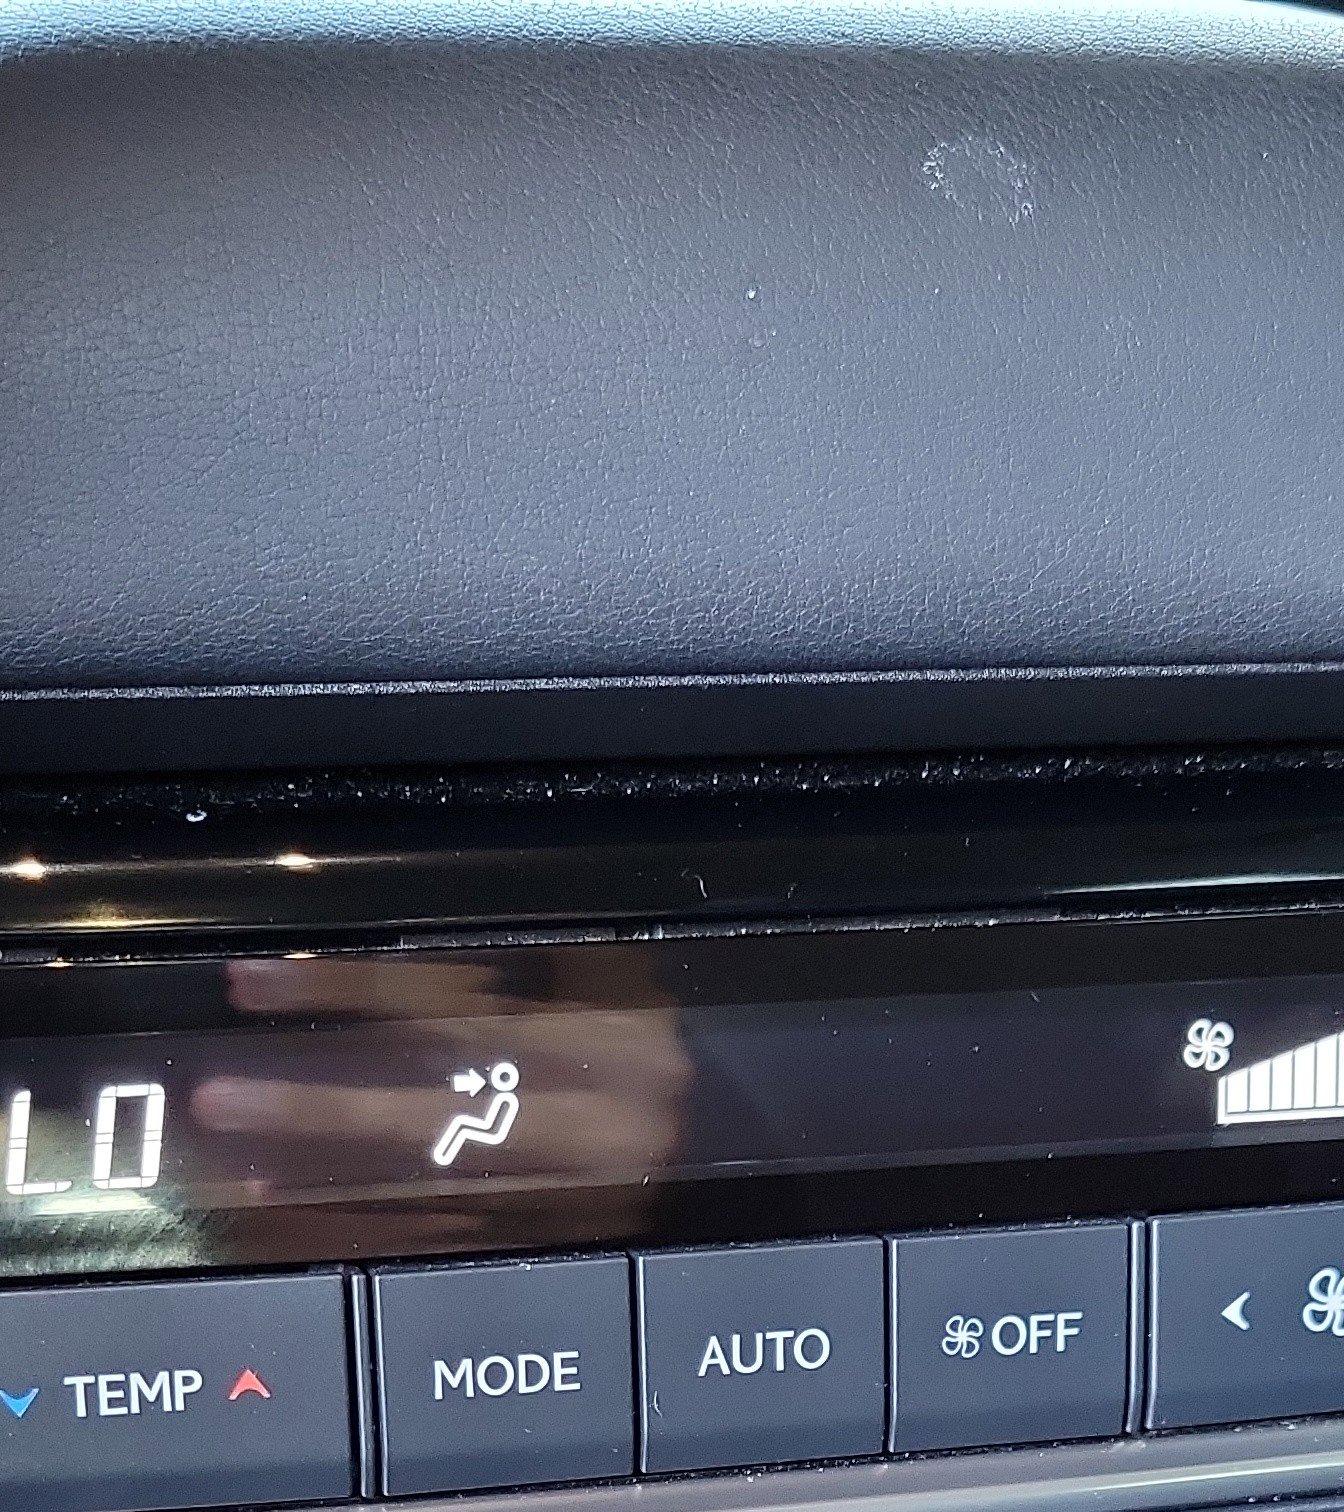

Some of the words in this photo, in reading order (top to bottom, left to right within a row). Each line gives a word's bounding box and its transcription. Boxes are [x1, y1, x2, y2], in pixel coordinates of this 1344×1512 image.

[697, 1328, 831, 1378] AUTO
[991, 1311, 1084, 1357] OFF
[64, 1369, 203, 1420] TEMP
[433, 1351, 581, 1401] MODE
